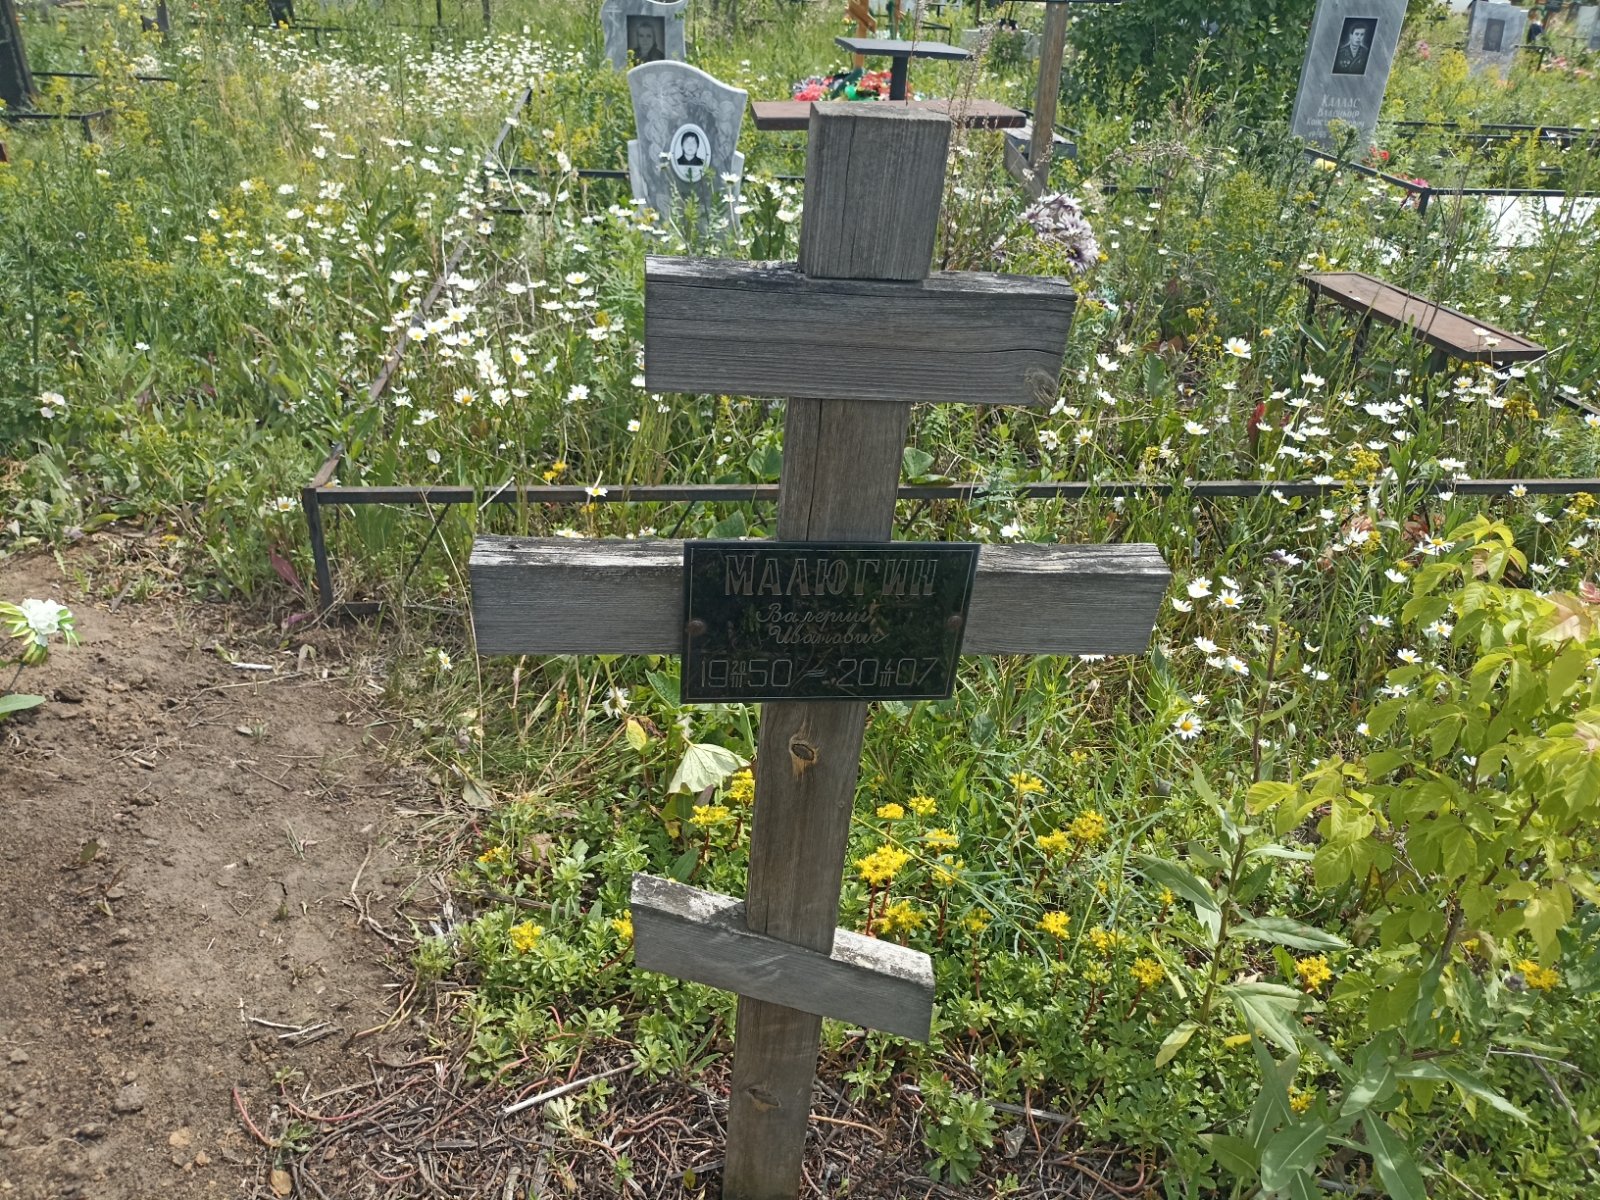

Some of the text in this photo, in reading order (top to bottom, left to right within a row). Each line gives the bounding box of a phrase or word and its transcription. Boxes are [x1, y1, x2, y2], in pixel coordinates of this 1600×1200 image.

[724, 554, 939, 596] МАЛЮГИН
[755, 602, 875, 631] Валерий
[768, 623, 890, 644] Иванович
